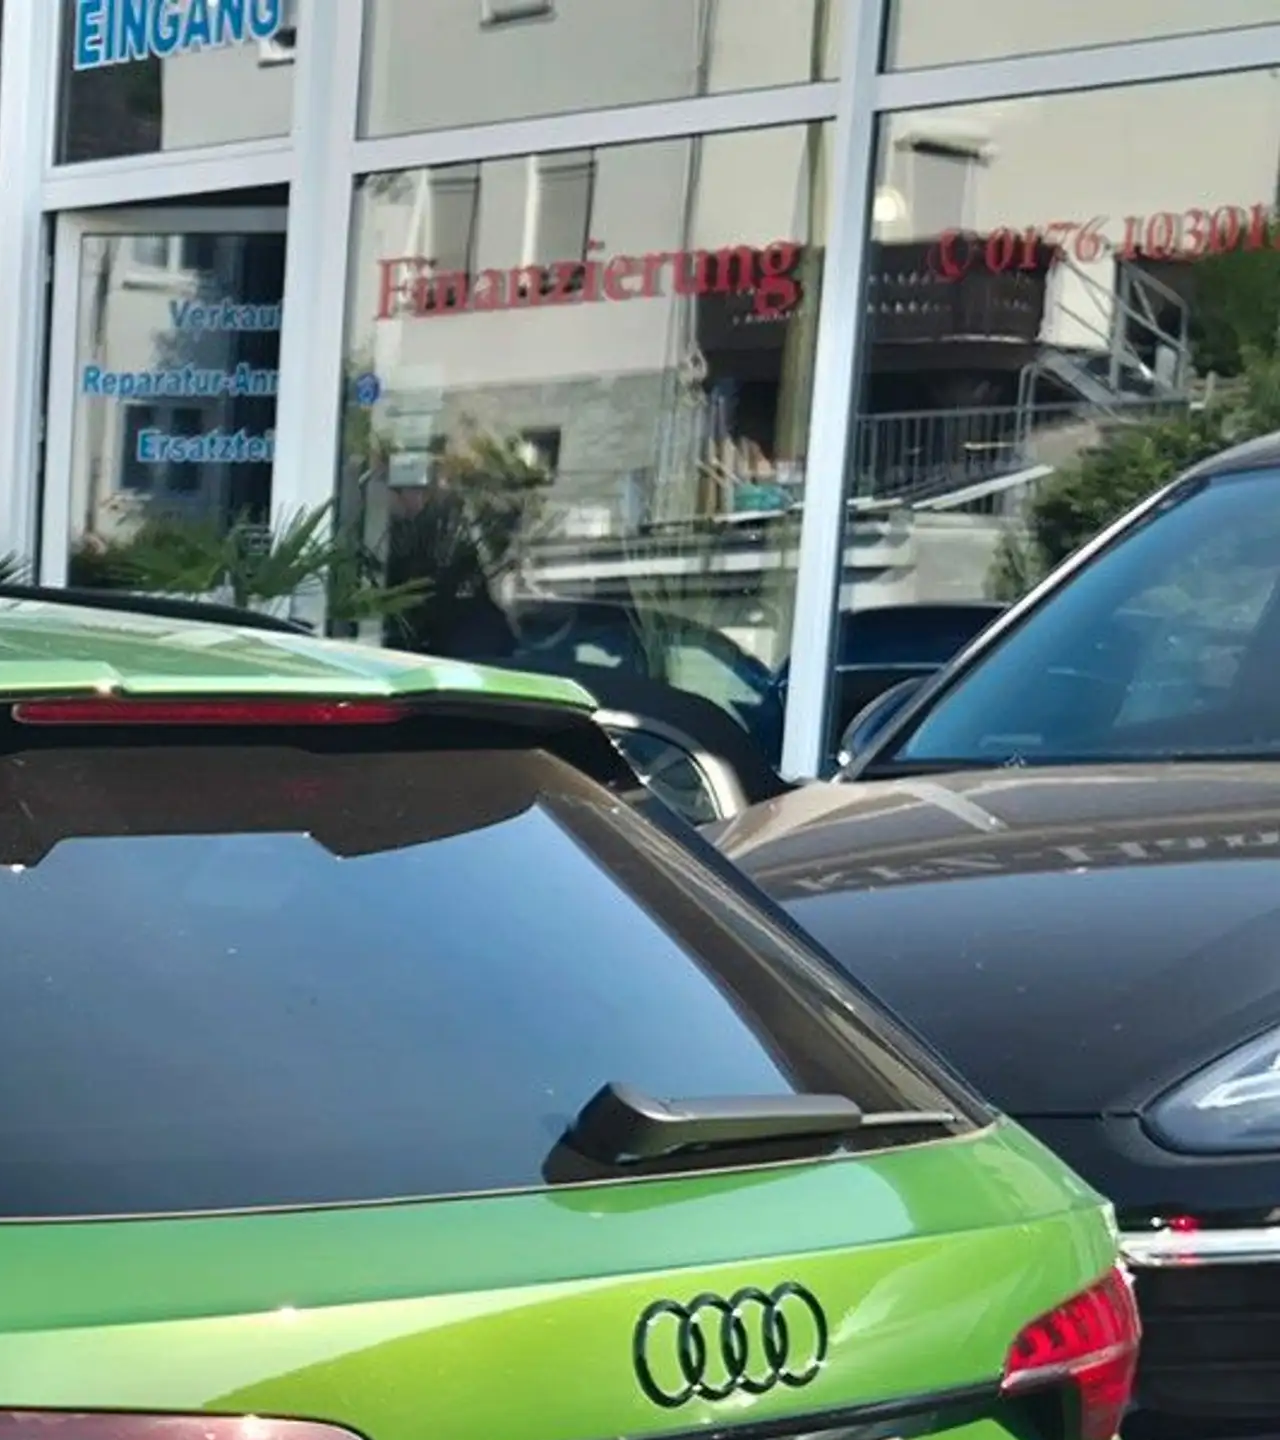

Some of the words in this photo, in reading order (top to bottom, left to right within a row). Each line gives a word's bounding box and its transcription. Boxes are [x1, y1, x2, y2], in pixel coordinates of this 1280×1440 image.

[74, 0, 282, 70] EINGANG
[984, 212, 1109, 274] 0176
[1116, 200, 1280, 262] 10301
[168, 296, 282, 331] Verkau
[374, 238, 806, 321] Finanzierung
